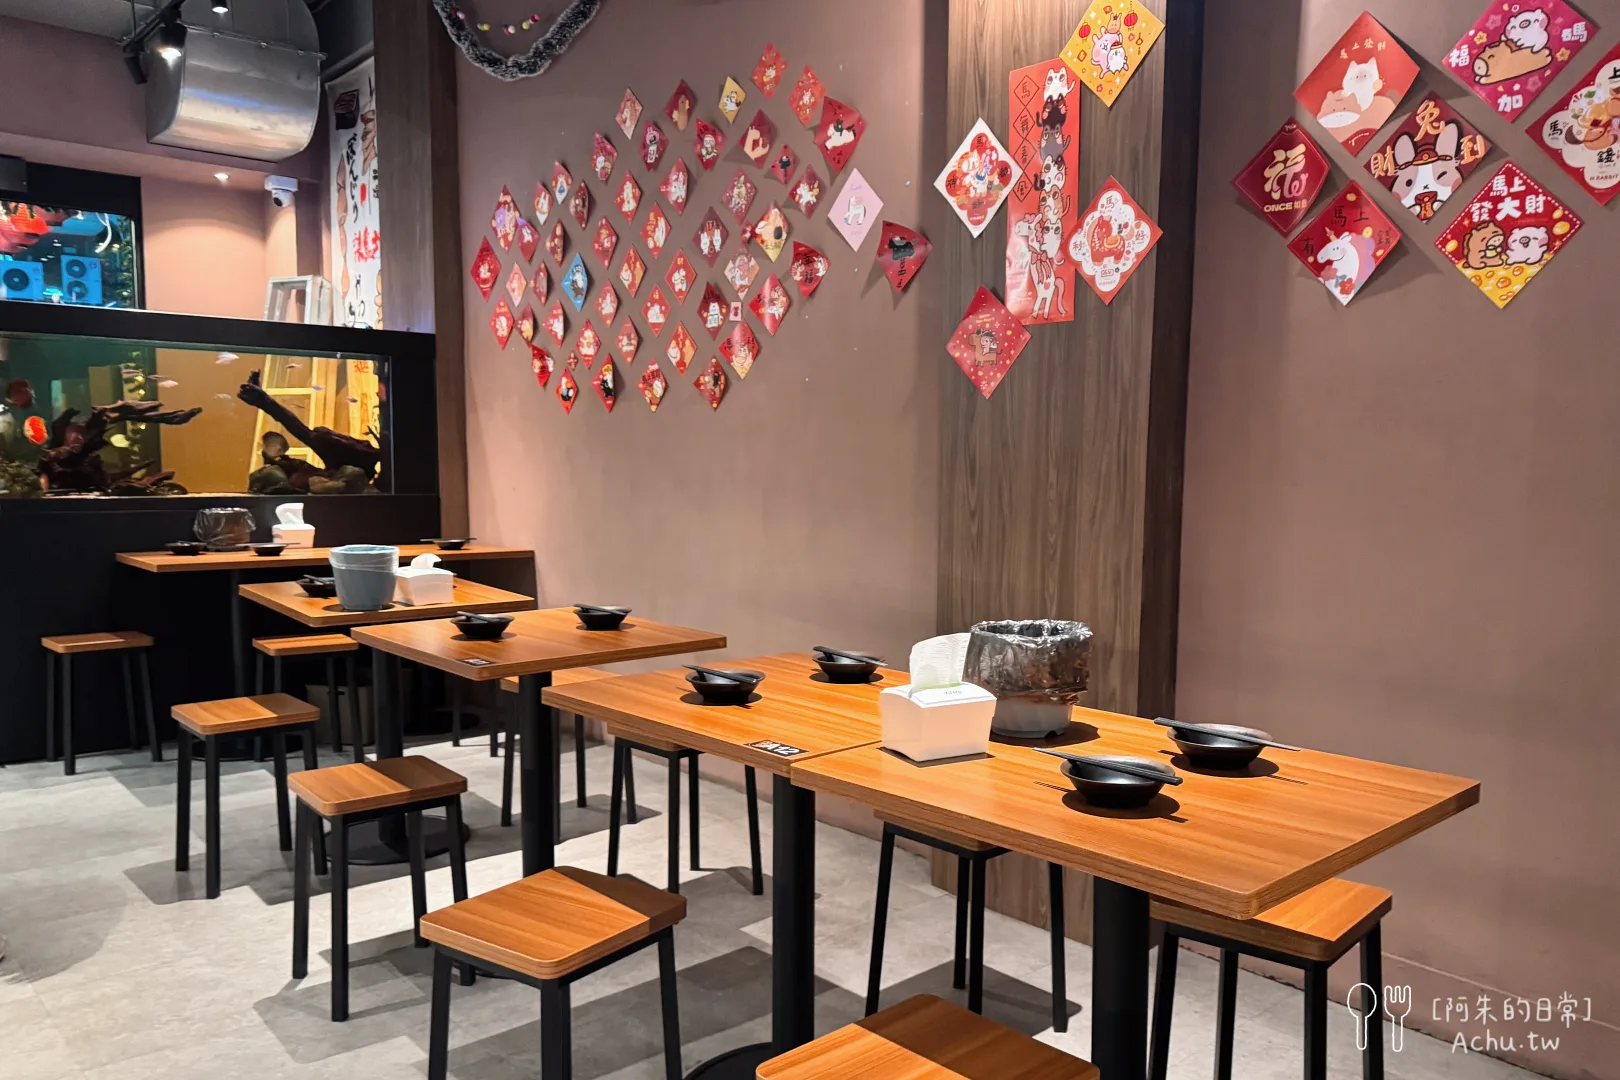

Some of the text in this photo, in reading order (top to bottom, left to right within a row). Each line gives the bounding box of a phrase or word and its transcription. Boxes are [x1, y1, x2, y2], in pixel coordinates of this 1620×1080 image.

[1448, 44, 1471, 68] 福
[1497, 93, 1523, 113] 加
[1459, 134, 1487, 165] 到
[1489, 175, 1527, 197] 馬上
[1263, 202, 1293, 213] ONCE
[1331, 206, 1369, 228] 馬上
[1470, 194, 1547, 223] 發大財
